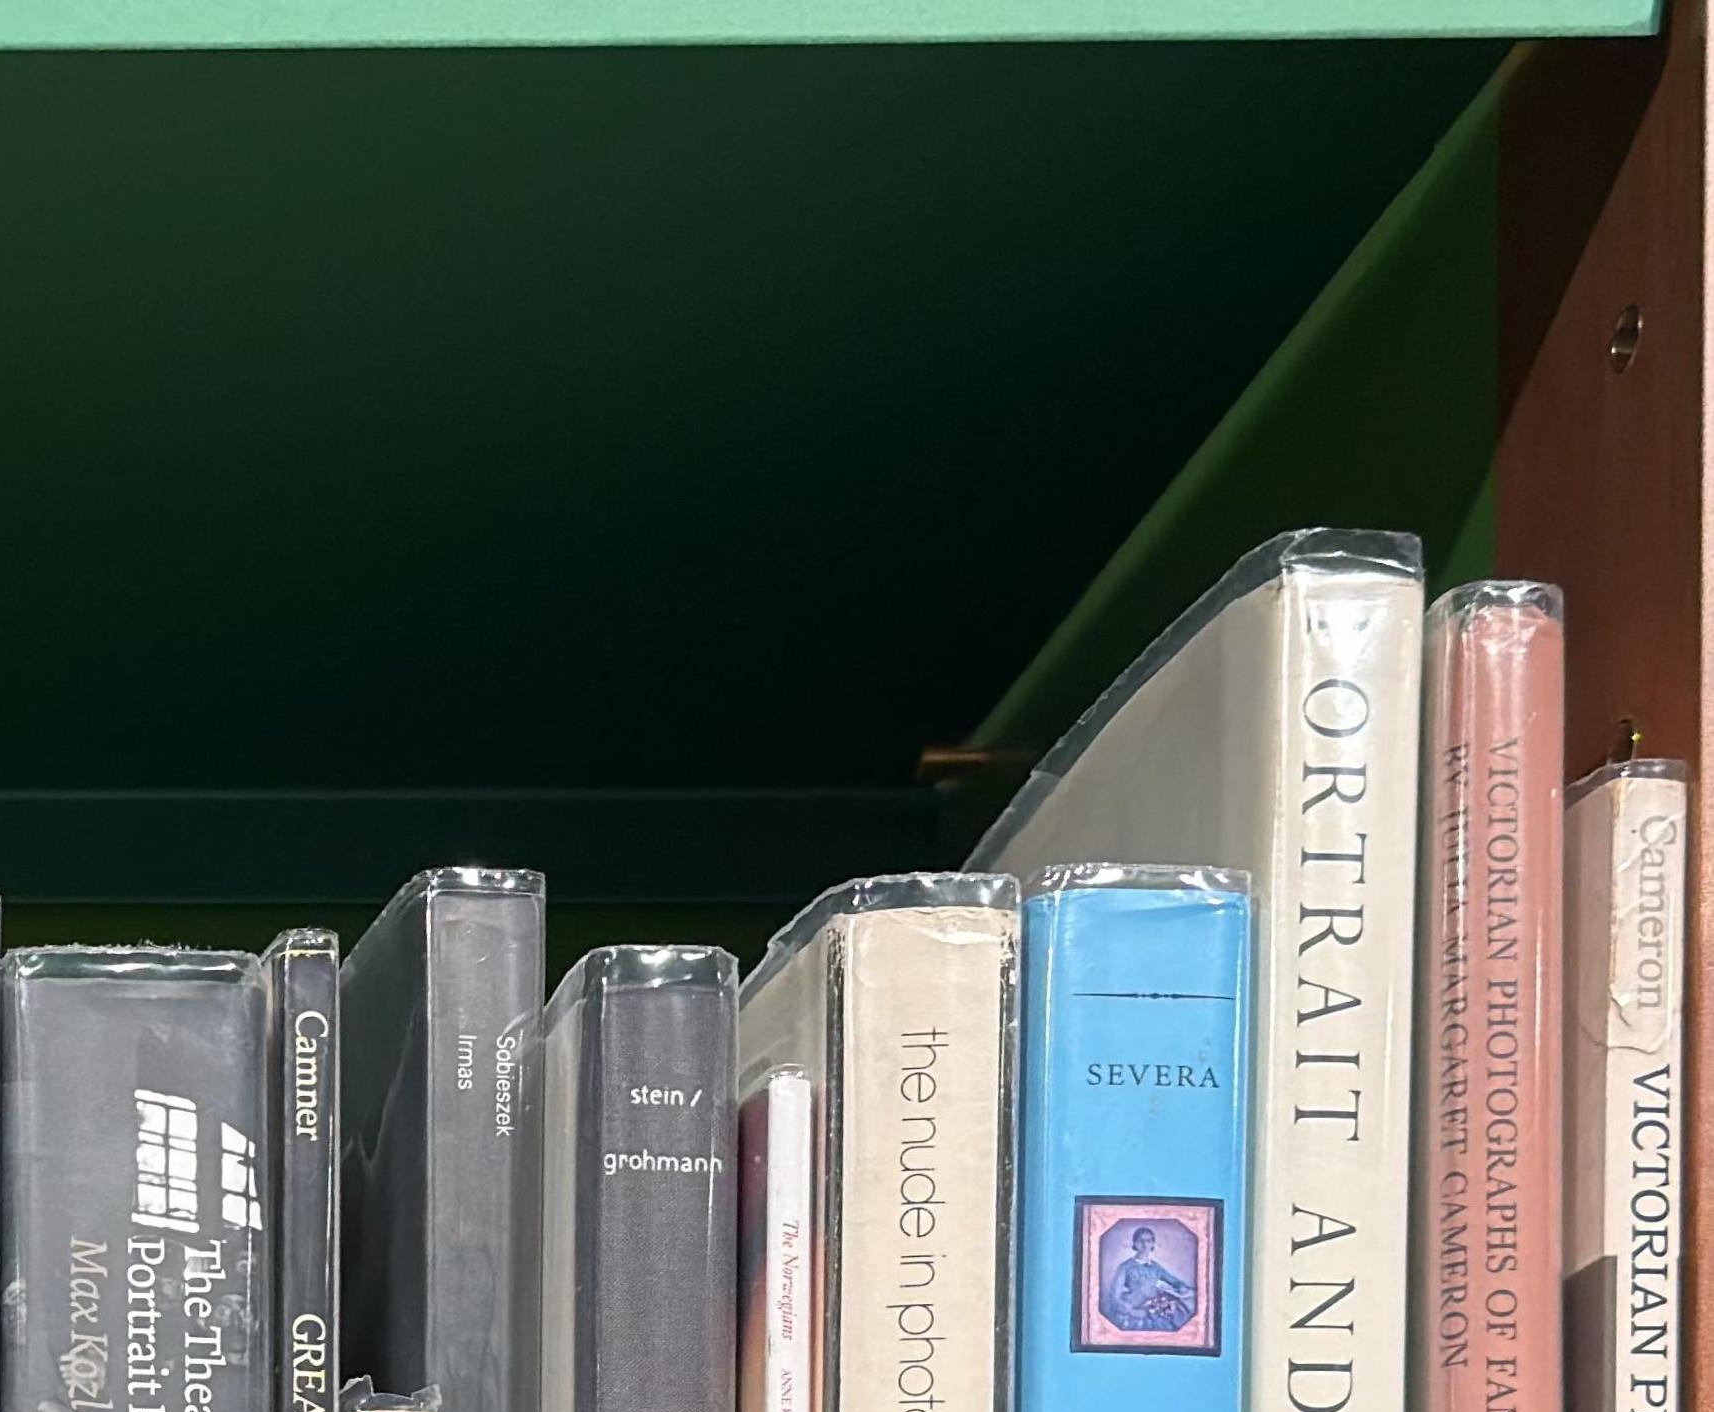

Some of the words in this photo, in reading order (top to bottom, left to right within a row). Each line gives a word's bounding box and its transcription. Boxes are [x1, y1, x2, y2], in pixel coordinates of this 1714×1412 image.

[1293, 616, 1371, 1141] ORTRAIT
[1487, 738, 1519, 961] VICTORIAN
[1634, 814, 1679, 1009] Cameron
[293, 1010, 329, 1142] Camner
[456, 1034, 475, 1090] Irmas
[494, 1034, 517, 1137] Sobieszek
[630, 1086, 685, 1106] stein
[1086, 1063, 1220, 1089] SEVERA
[603, 1149, 722, 1175] grohmann
[1485, 980, 1519, 1275] PHOTOGRAPHS
[1628, 1064, 1671, 1359] VICTORIAN
[70, 1236, 108, 1324] Max
[184, 1240, 226, 1318] The
[1485, 1289, 1517, 1340] OF
